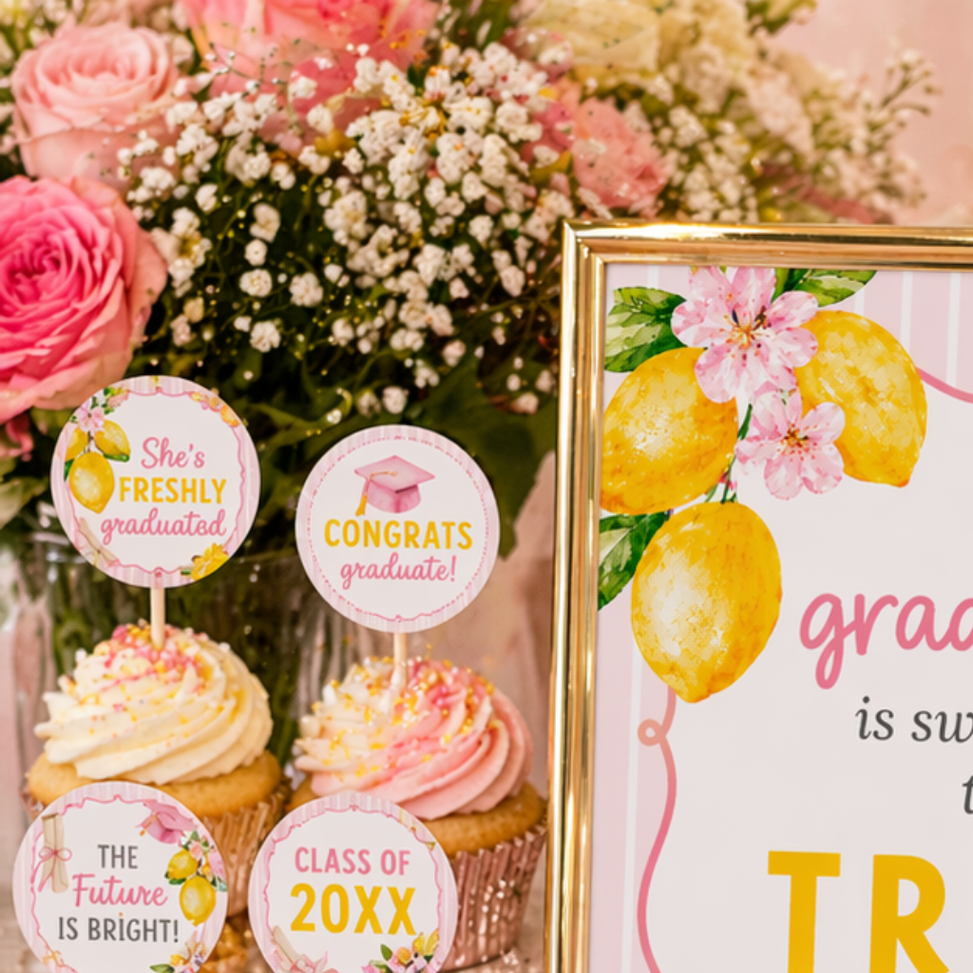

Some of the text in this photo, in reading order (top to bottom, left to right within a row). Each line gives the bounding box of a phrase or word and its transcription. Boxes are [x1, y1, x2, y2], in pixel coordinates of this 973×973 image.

[141, 437, 204, 469] She's
[119, 476, 227, 504] FRESHLY
[324, 518, 473, 550] CONGRATS
[340, 553, 457, 591] graduate!
[855, 696, 894, 741] is
[98, 844, 138, 869] THE
[294, 847, 410, 876] CLASS OF
[72, 873, 168, 907] Future
[289, 883, 417, 936] 20XX
[59, 917, 78, 940] IS
